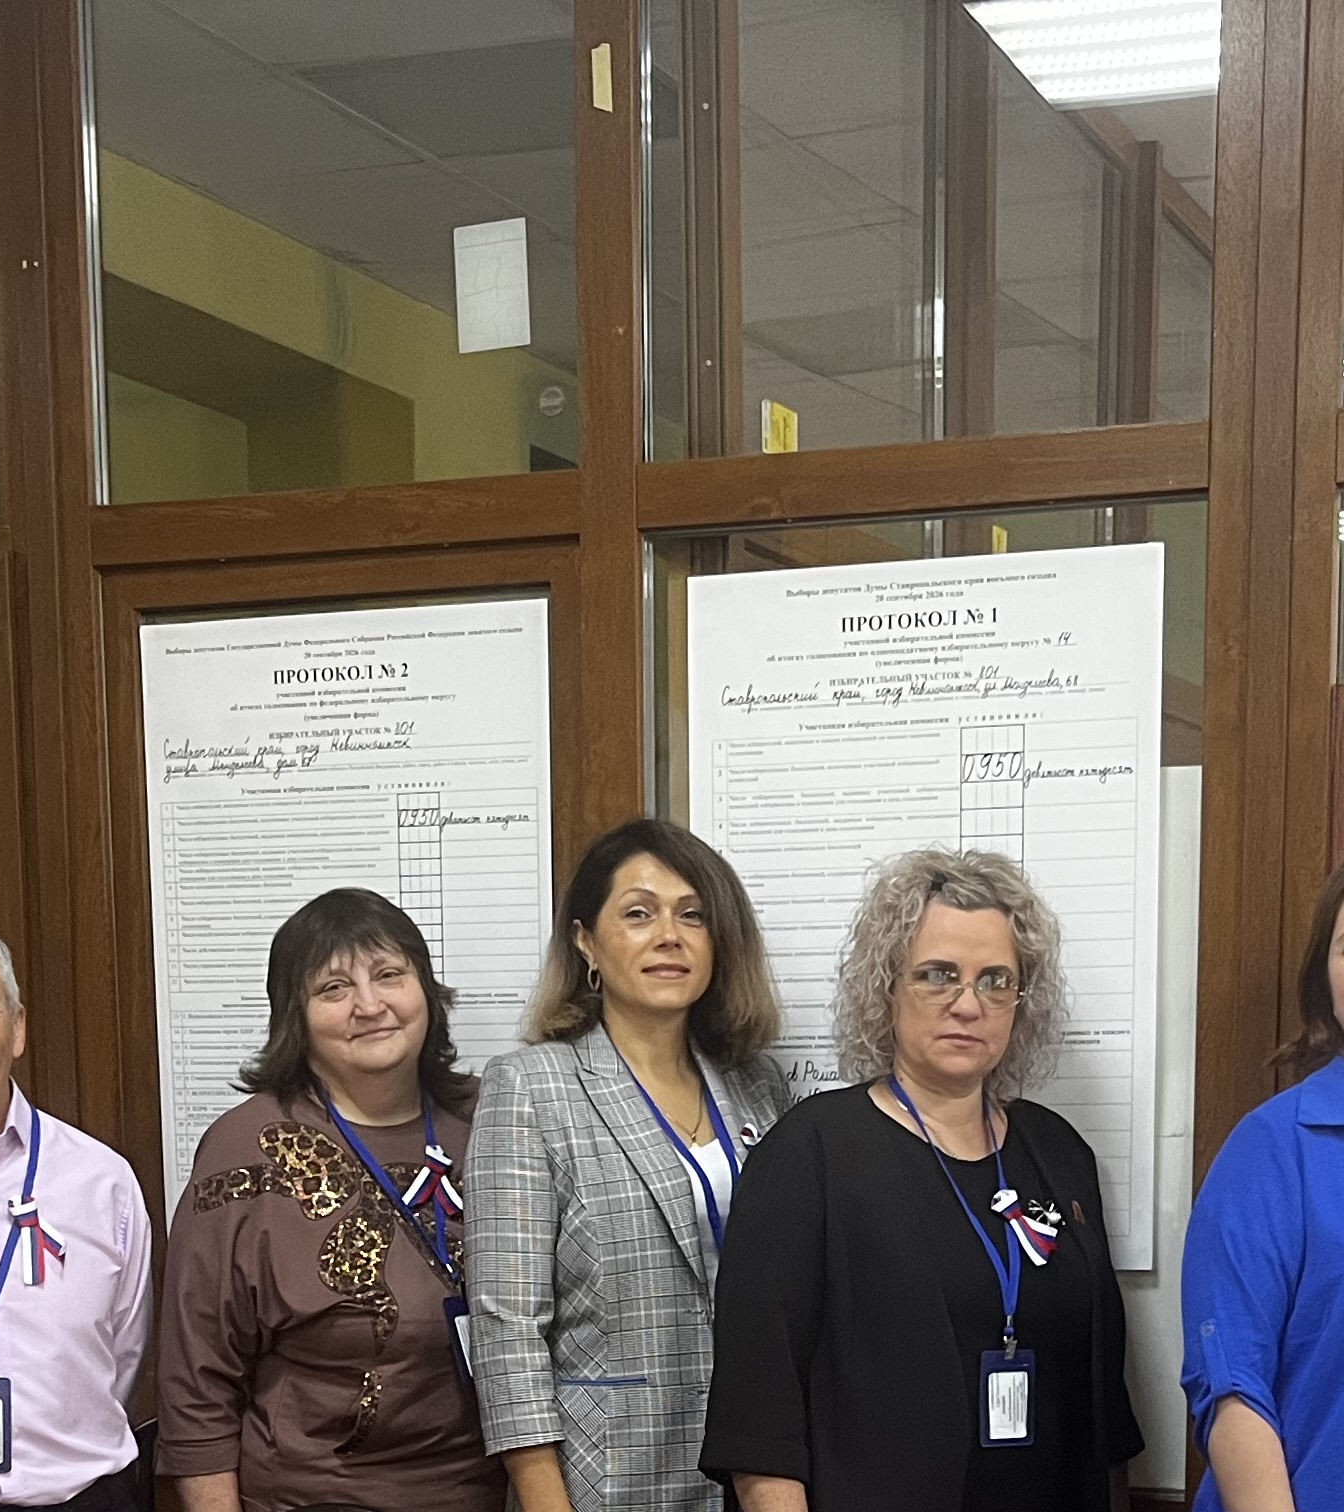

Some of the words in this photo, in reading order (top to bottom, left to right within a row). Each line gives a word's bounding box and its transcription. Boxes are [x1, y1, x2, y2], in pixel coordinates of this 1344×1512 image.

[841, 610, 957, 633] ПРОТОКОЛ
[963, 608, 985, 625] №
[991, 607, 997, 623] 1
[273, 665, 373, 684] ПРОТОКОЛ
[378, 664, 396, 679] №
[401, 663, 408, 678] 2
